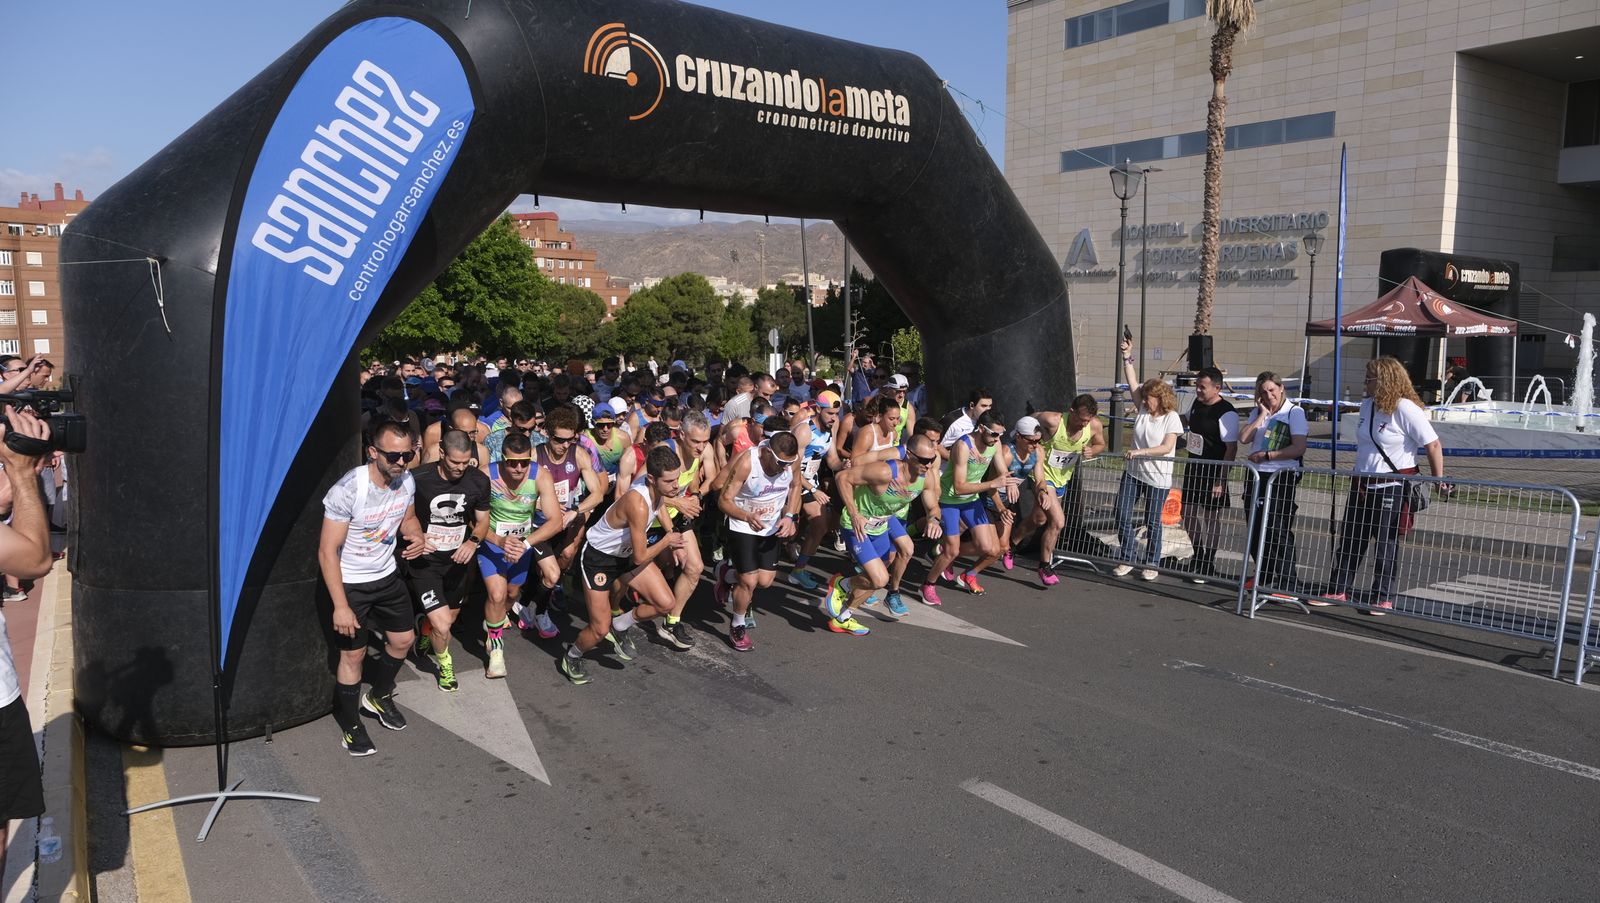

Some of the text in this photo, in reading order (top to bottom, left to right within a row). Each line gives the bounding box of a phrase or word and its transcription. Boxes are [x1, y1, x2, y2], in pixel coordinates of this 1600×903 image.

[757, 109, 910, 143] cronometraje deportivo
[349, 118, 465, 301] centrohogarsanchez.es
[1204, 211, 1329, 235] IVERSITARIO
[1143, 241, 1298, 264] TORRERDENAS
[1189, 269, 1240, 281] MRNO
[1054, 456, 1074, 468] 127
